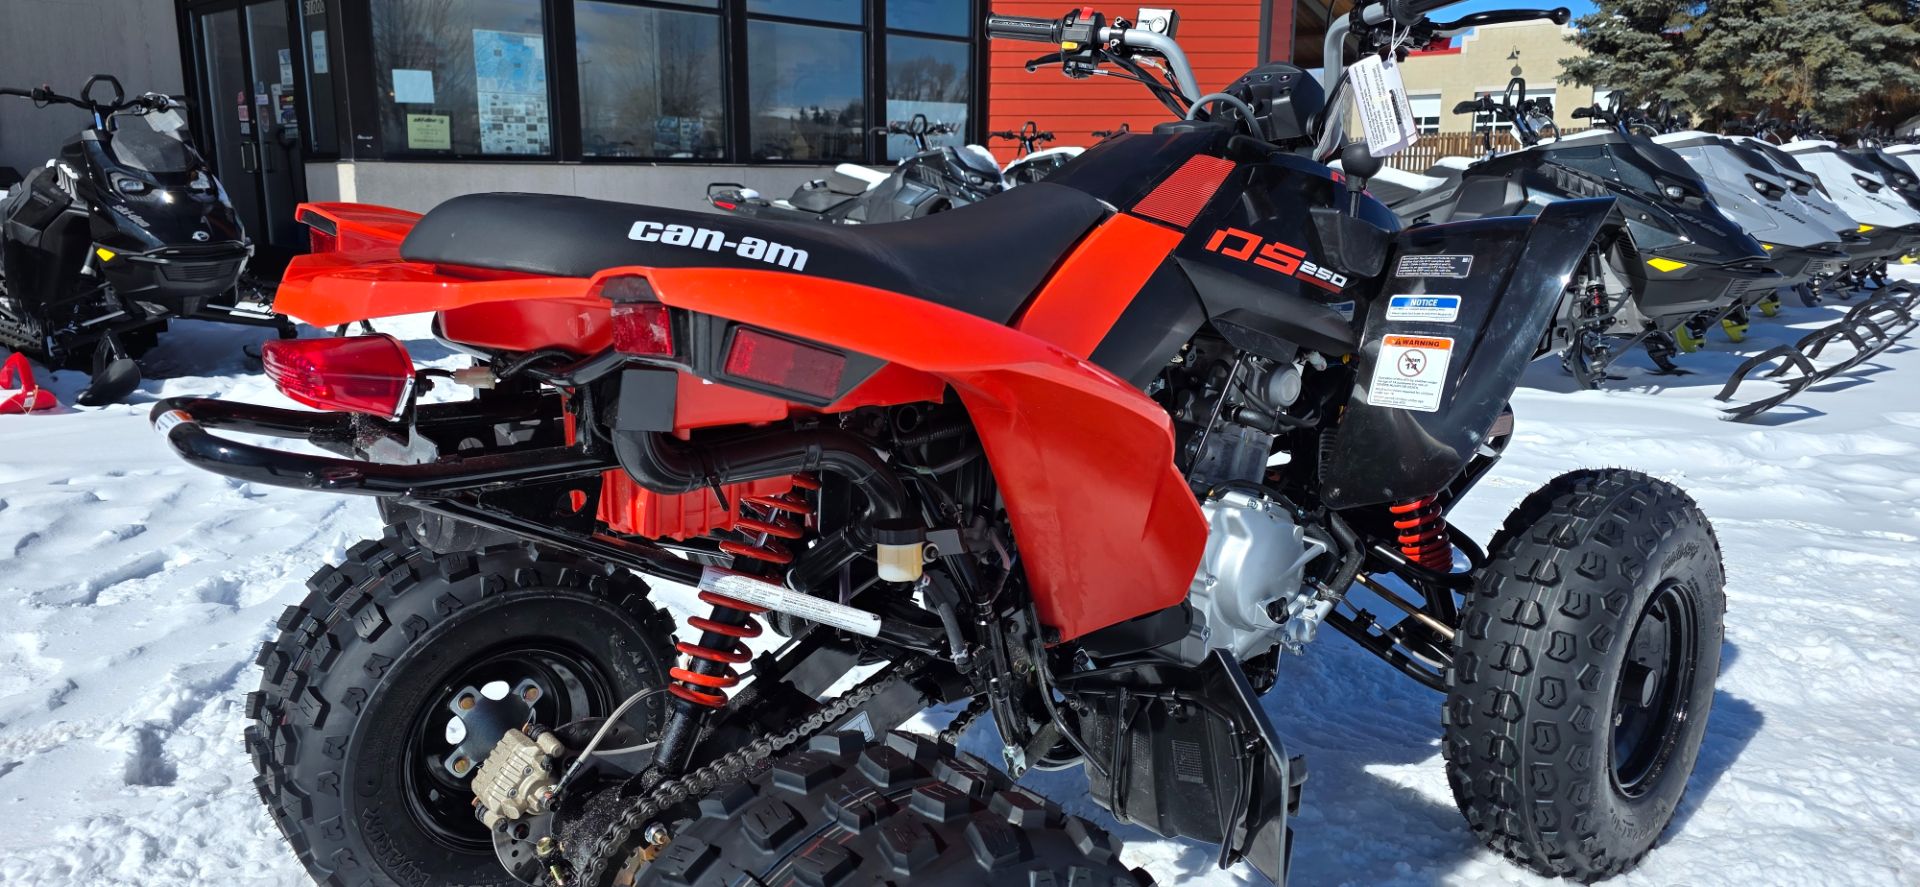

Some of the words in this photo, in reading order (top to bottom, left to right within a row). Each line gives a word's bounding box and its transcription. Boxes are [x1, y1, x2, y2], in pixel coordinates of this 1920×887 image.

[1765, 203, 1807, 224] ski-doo
[627, 220, 809, 272] can-am
[1205, 227, 1307, 276] DS
[1299, 260, 1348, 288] 250
[1402, 339, 1440, 347] WARNING
